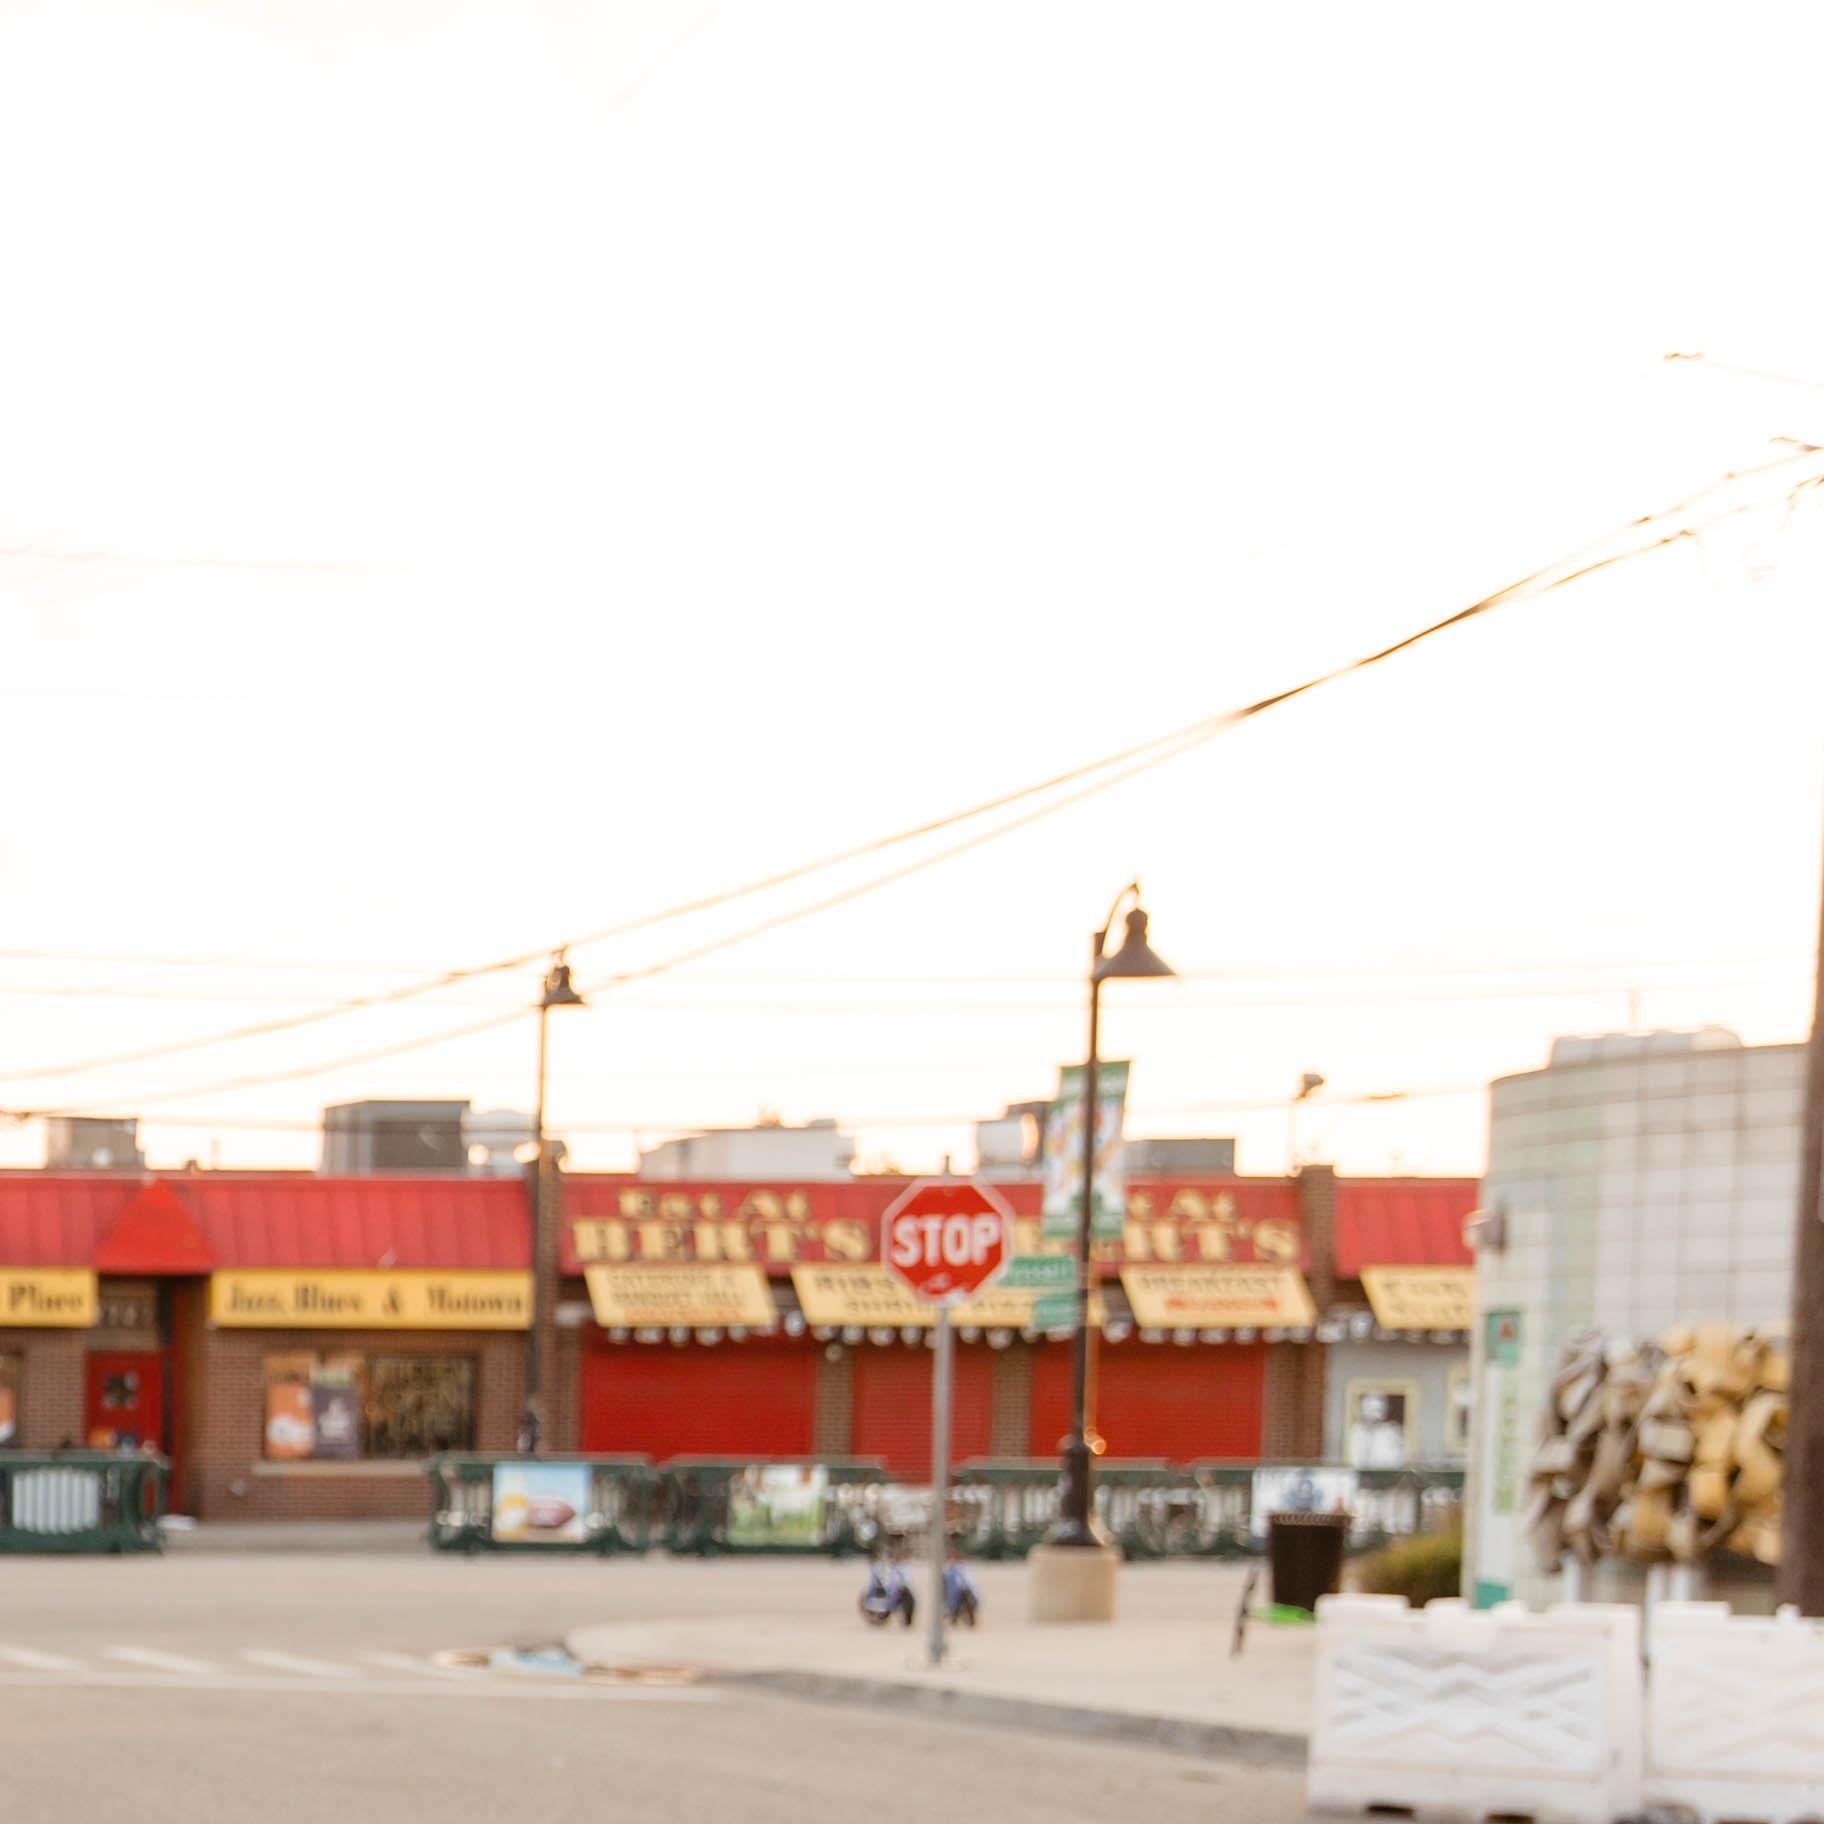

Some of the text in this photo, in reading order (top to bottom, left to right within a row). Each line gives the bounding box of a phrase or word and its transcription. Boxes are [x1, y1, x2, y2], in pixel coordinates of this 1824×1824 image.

[574, 1218, 870, 1262] BERT'S
[892, 1212, 1001, 1267] STOP
[8, 1283, 84, 1314] Place
[293, 1281, 362, 1313] Blues
[382, 1285, 402, 1316] &
[426, 1283, 522, 1314] Motown
